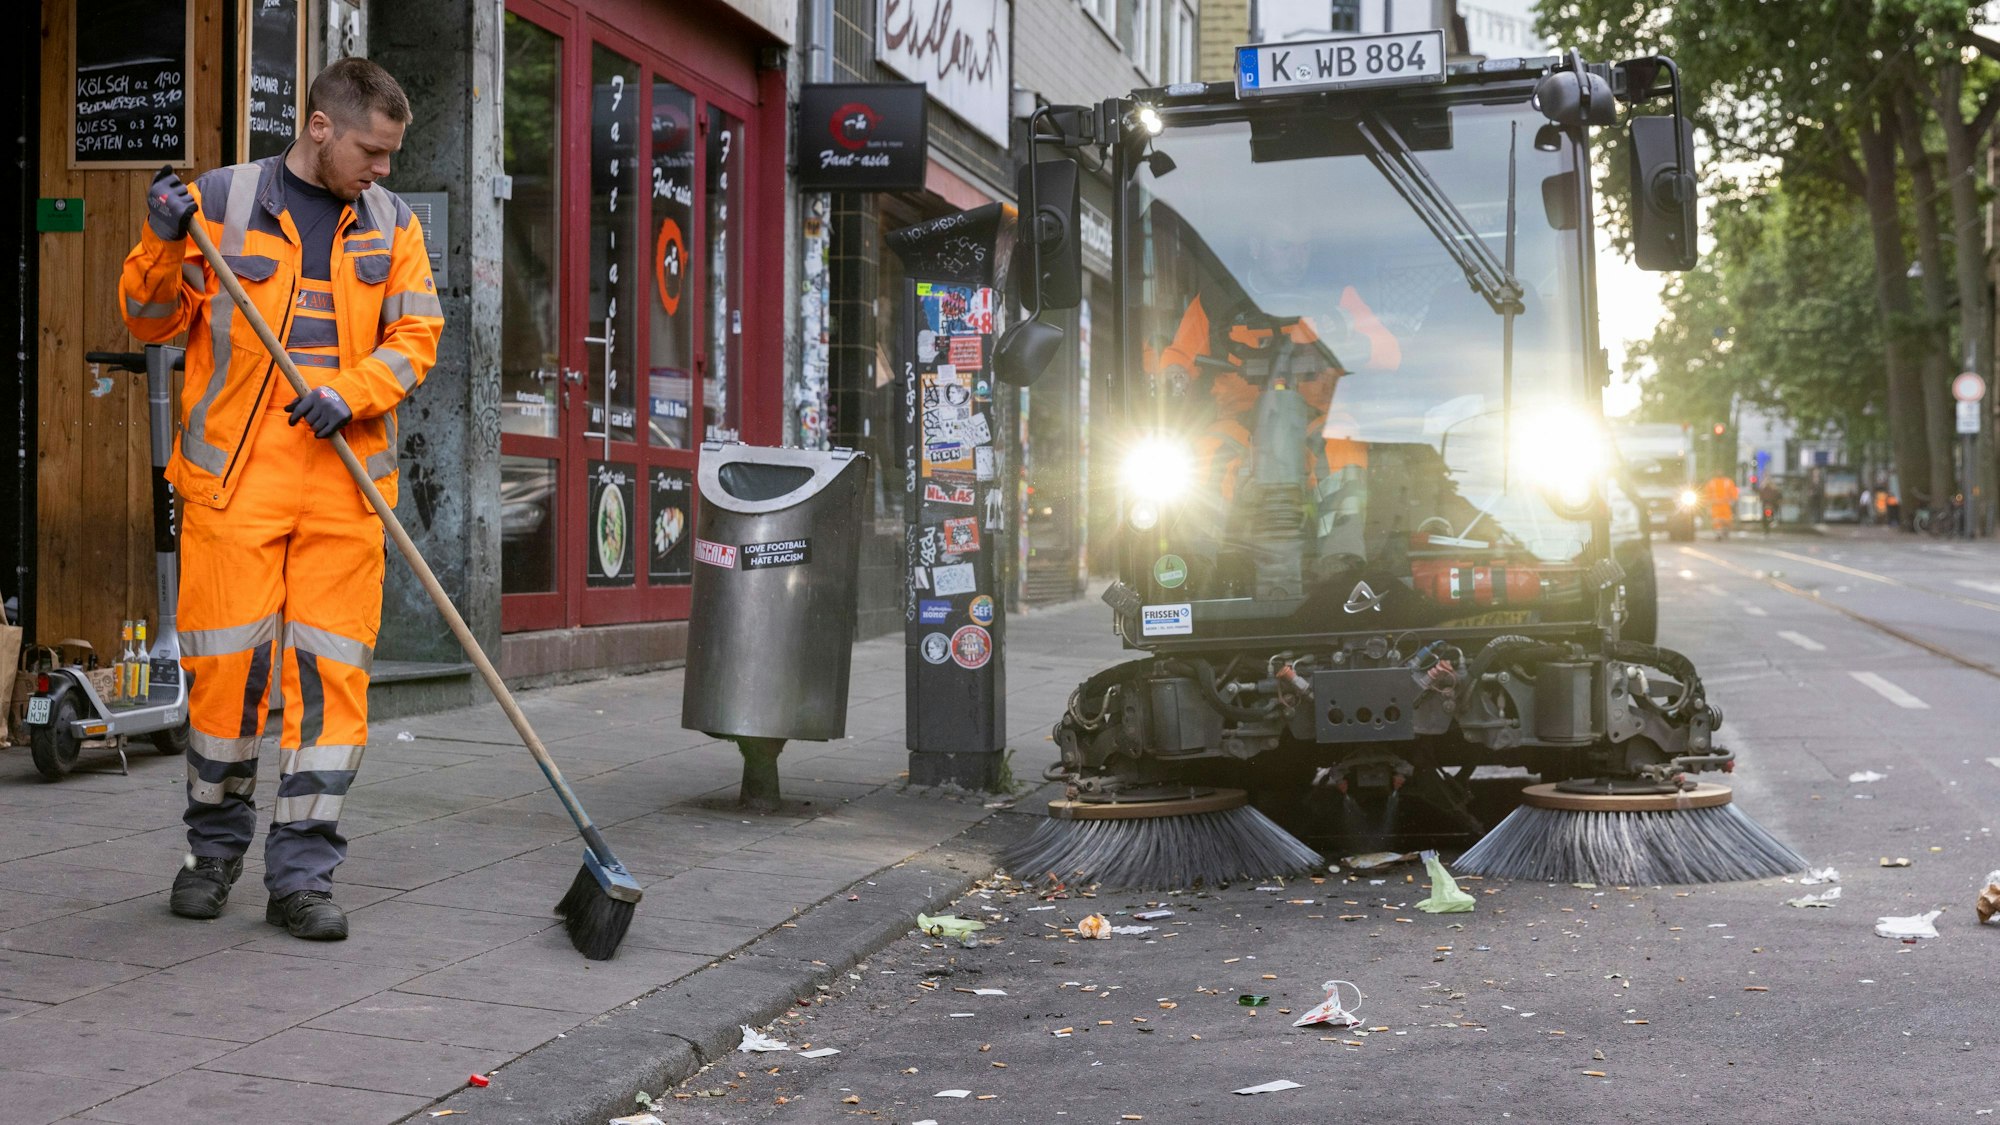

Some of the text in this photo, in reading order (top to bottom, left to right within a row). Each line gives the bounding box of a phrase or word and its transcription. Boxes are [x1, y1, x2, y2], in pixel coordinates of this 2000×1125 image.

[1271, 40, 1426, 82] K WB 884
[78, 71, 181, 97] KÖLSCH 0.2 1,90
[1246, 72, 1254, 83] D
[152, 88, 183, 109] 3,10
[76, 118, 118, 135] WIESS
[129, 120, 145, 130] 0.3
[76, 134, 124, 152] SPATEN
[152, 133, 179, 149] 4,90
[819, 149, 890, 170] Fant-asia
[744, 540, 807, 554] LOVE FOOTBALL
[750, 553, 804, 566] HATE RACISM
[1144, 609, 1180, 619] FRISSEN
[31, 700, 49, 711] 303
